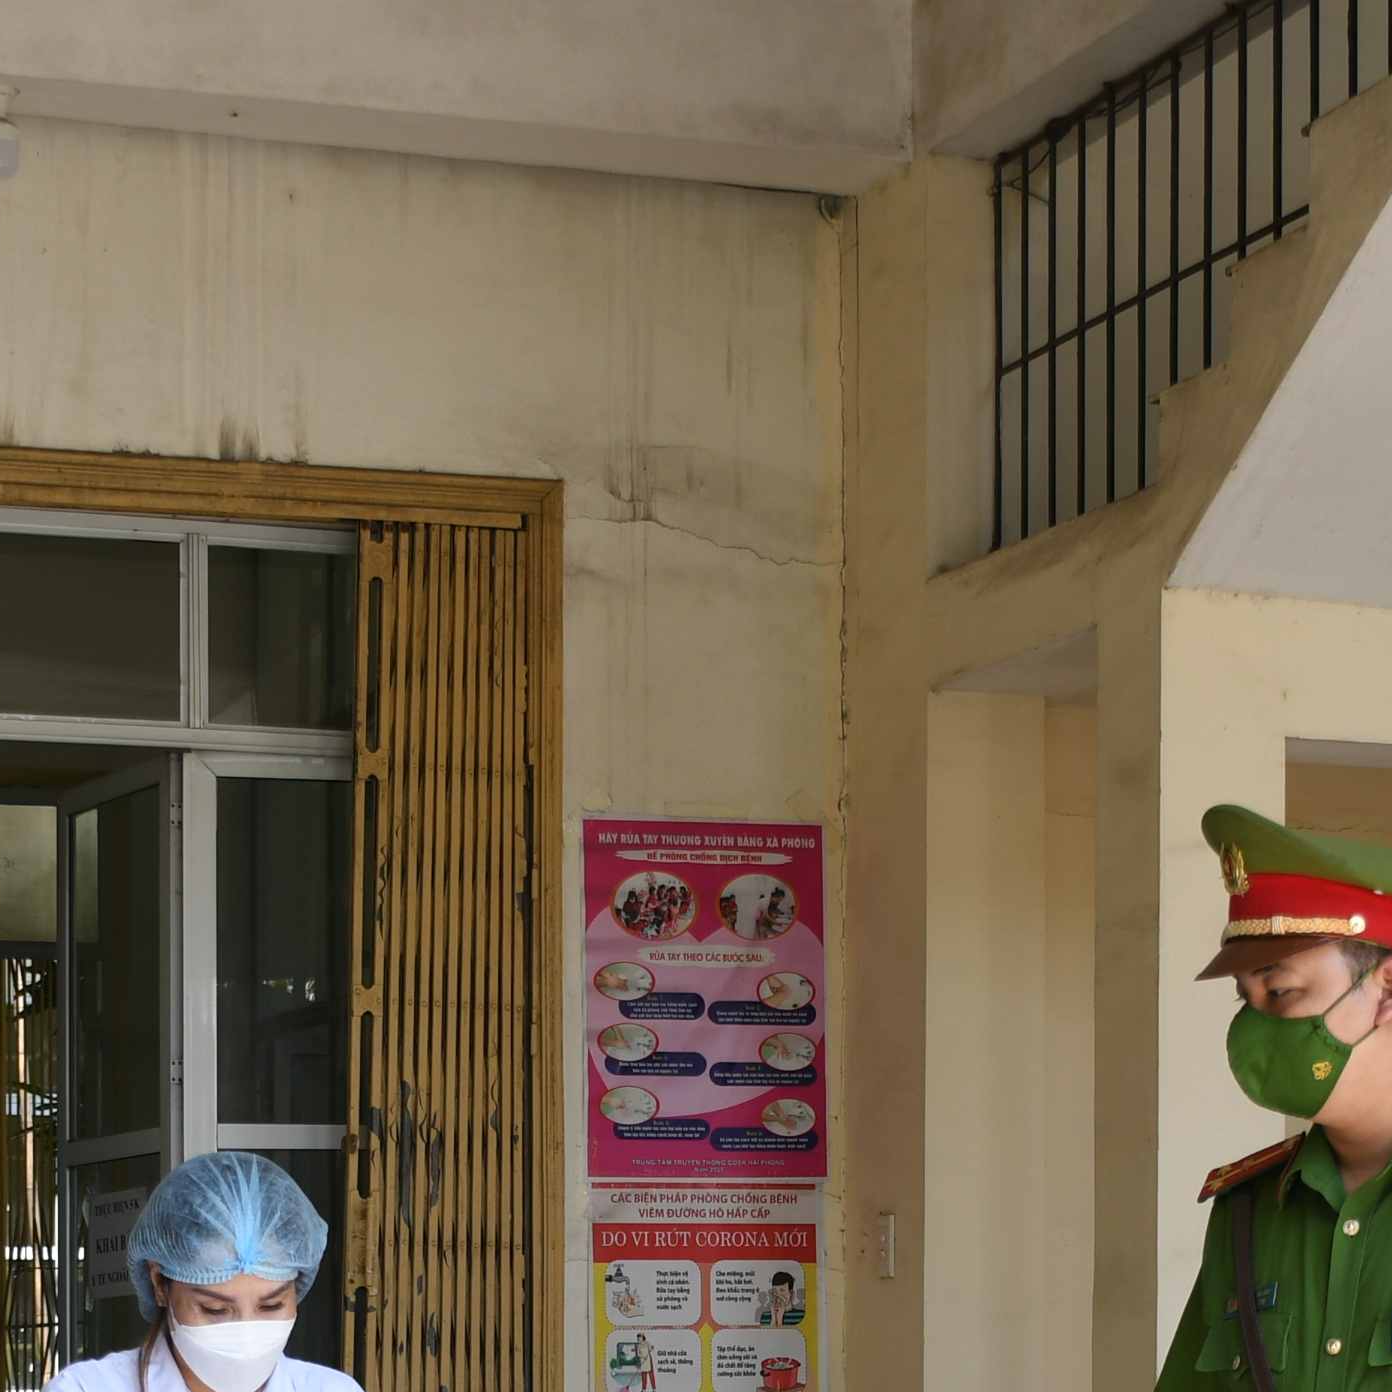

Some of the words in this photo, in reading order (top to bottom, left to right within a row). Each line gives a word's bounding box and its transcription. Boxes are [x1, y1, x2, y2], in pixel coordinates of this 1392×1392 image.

[642, 835, 658, 844] TAY
[668, 953, 681, 961] TAY
[683, 953, 703, 961] THEO
[611, 1192, 632, 1203] CÁC
[634, 1192, 657, 1206] BIỆN
[660, 1192, 688, 1203] PHÁP
[691, 1192, 727, 1203] PHÒNG
[730, 1192, 767, 1204] CHỐNG
[770, 1193, 797, 1206] BỆNH
[639, 1207, 664, 1218] VIÊM
[667, 1207, 706, 1218] ĐƯỜNG
[709, 1207, 724, 1218] HÔ
[727, 1206, 748, 1218] HẤP
[751, 1206, 771, 1218] CẤP
[601, 1231, 627, 1246] DO
[631, 1231, 649, 1246] VI
[654, 1228, 691, 1247] RÚT
[696, 1231, 769, 1247] CORONA
[774, 1228, 807, 1247] MỚI
